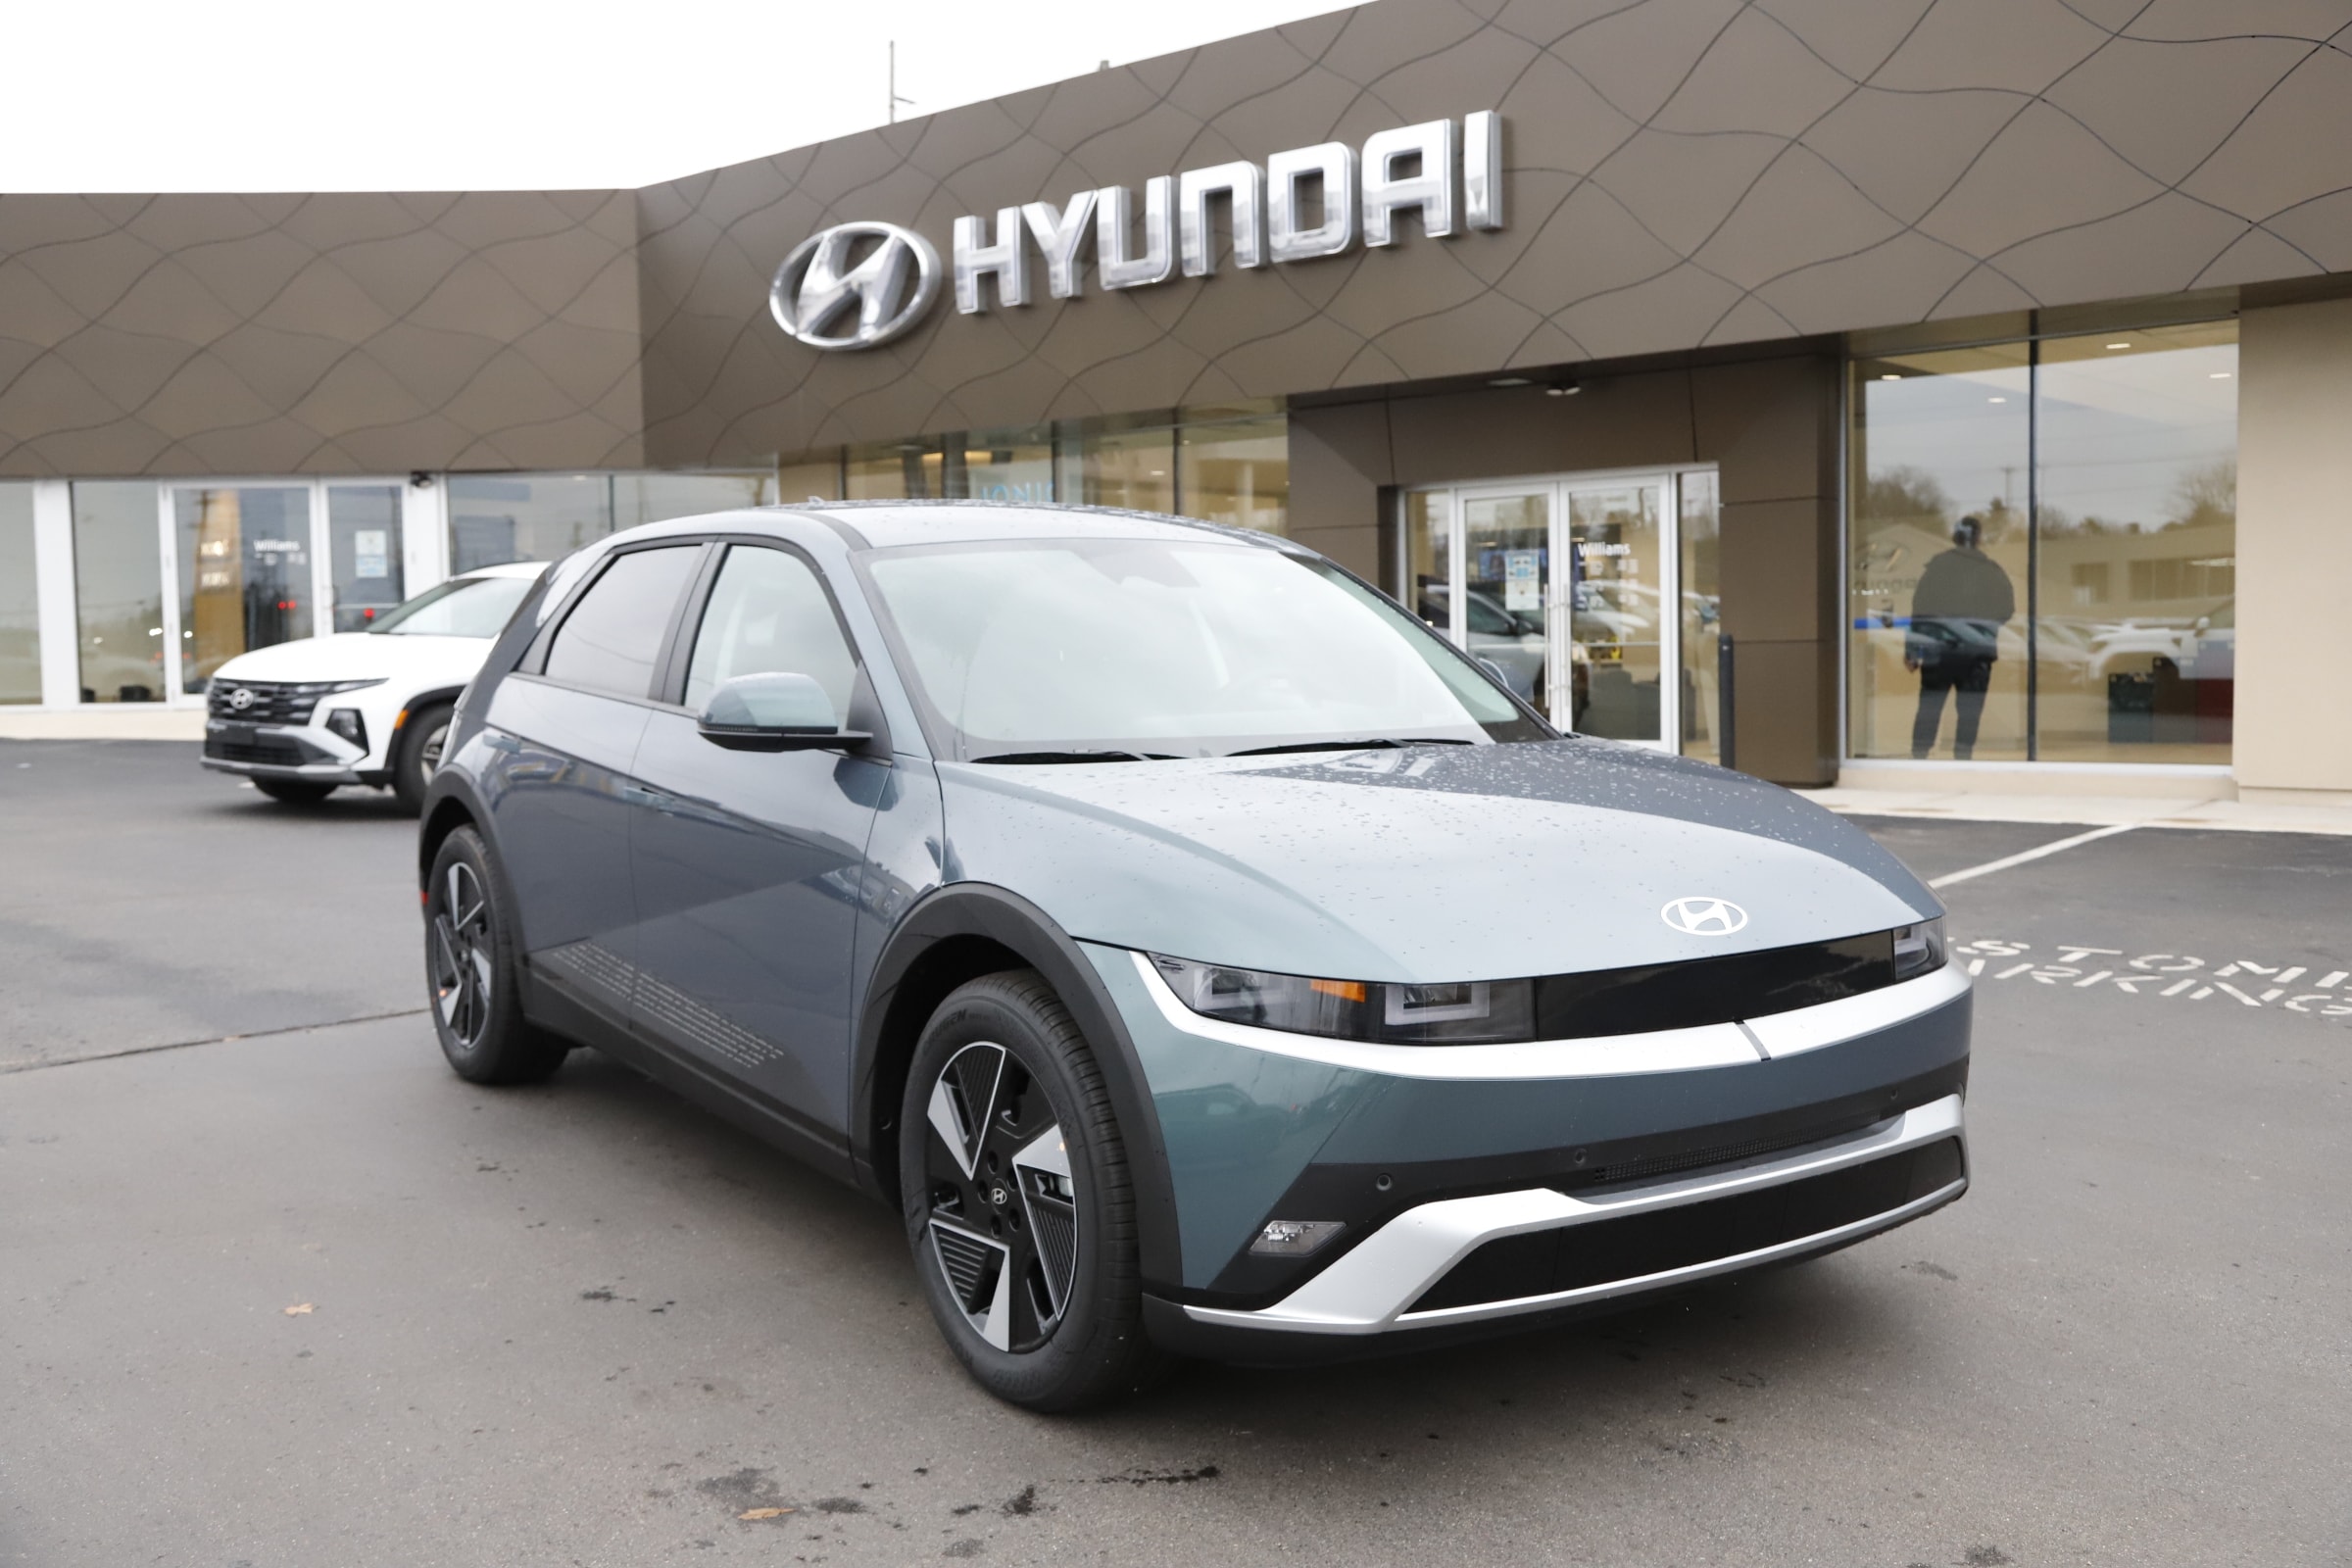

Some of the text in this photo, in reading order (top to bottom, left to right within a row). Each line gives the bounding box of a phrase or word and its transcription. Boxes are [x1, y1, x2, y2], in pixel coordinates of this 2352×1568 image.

[953, 109, 1503, 316] HYUNDAI
[253, 539, 300, 552] Williams
[1577, 541, 1631, 557] Williams
[1946, 937, 2352, 989] STOM
